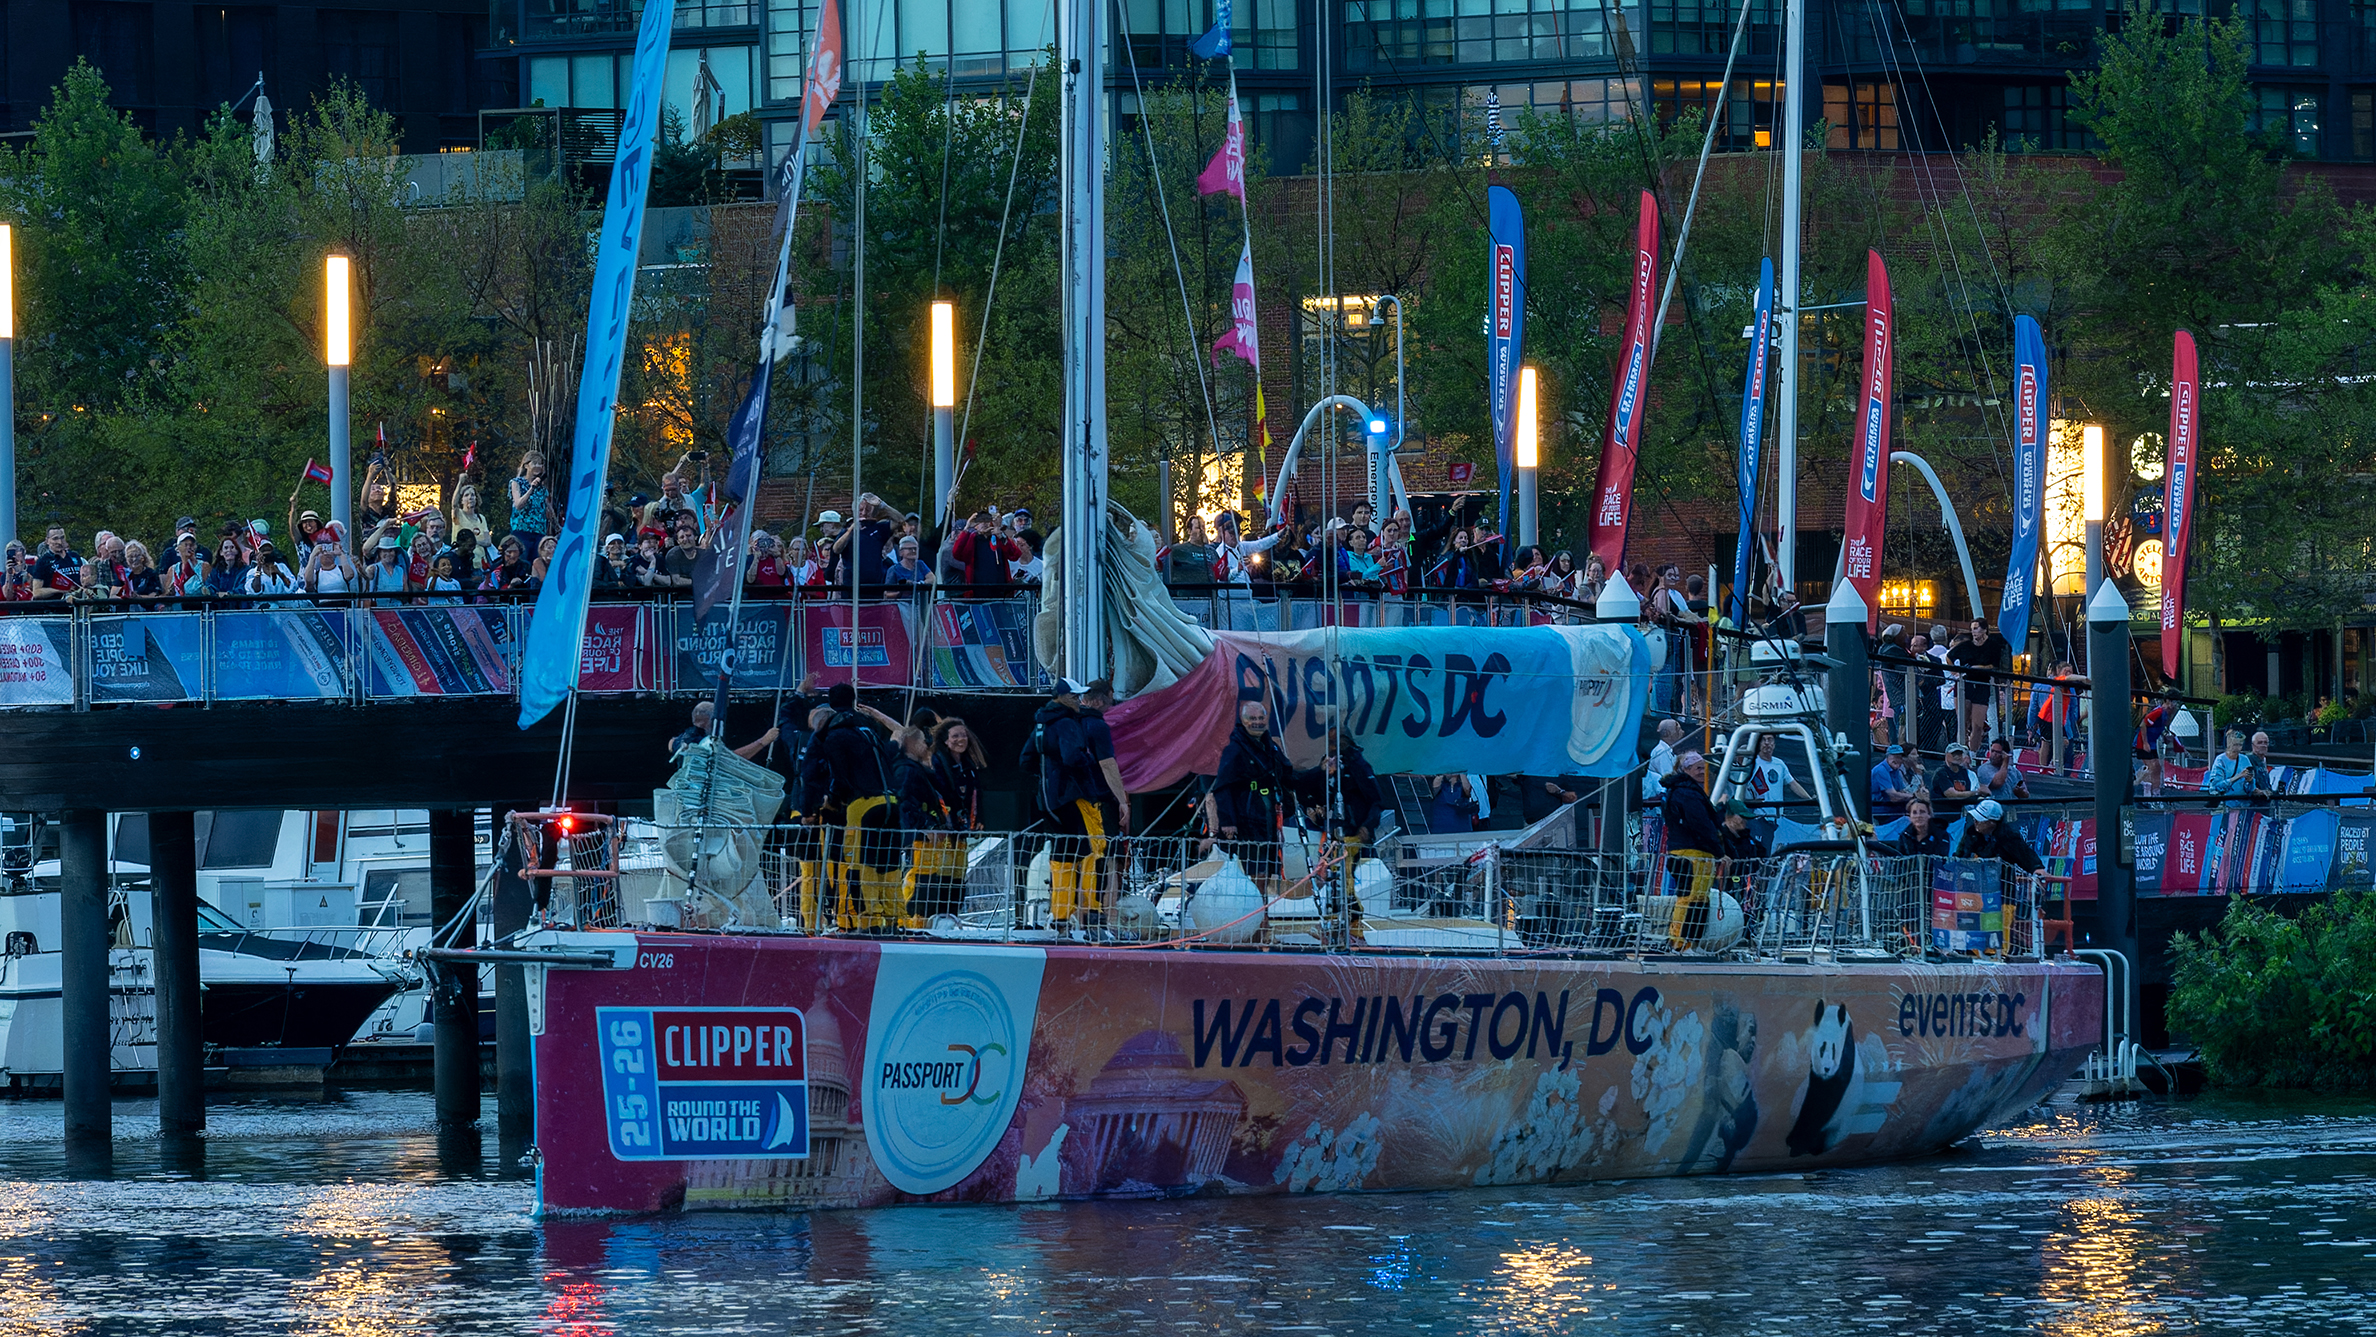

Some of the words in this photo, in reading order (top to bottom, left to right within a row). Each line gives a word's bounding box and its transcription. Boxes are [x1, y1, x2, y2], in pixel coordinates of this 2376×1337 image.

[1499, 253, 1509, 331] CLIPPER
[2176, 389, 2189, 458] CLIPPER
[1370, 451, 1379, 525] Emergency
[1602, 493, 1621, 505] RACE
[1599, 512, 1623, 526] LIFE
[1848, 546, 1871, 558] RACE
[2137, 544, 2163, 563] STELL
[1847, 563, 1871, 579] LIFE
[2137, 567, 2163, 584] ARTO
[2002, 592, 2023, 612] LIFE
[2136, 612, 2160, 621] QUAL
[2163, 614, 2175, 631] FE
[2340, 839, 2365, 851] PEOPLE
[2179, 858, 2196, 874] LIFE
[639, 953, 674, 969] CV26
[1192, 990, 1574, 1072] WASHINGTON,
[1586, 985, 1660, 1057] DC
[664, 1024, 793, 1068] CLIPPER
[609, 1018, 652, 1148] 25-26
[881, 1061, 964, 1090] PASSPORT
[667, 1100, 724, 1117] ROUND
[728, 1100, 761, 1117] THE
[667, 1116, 760, 1142] WORLD
